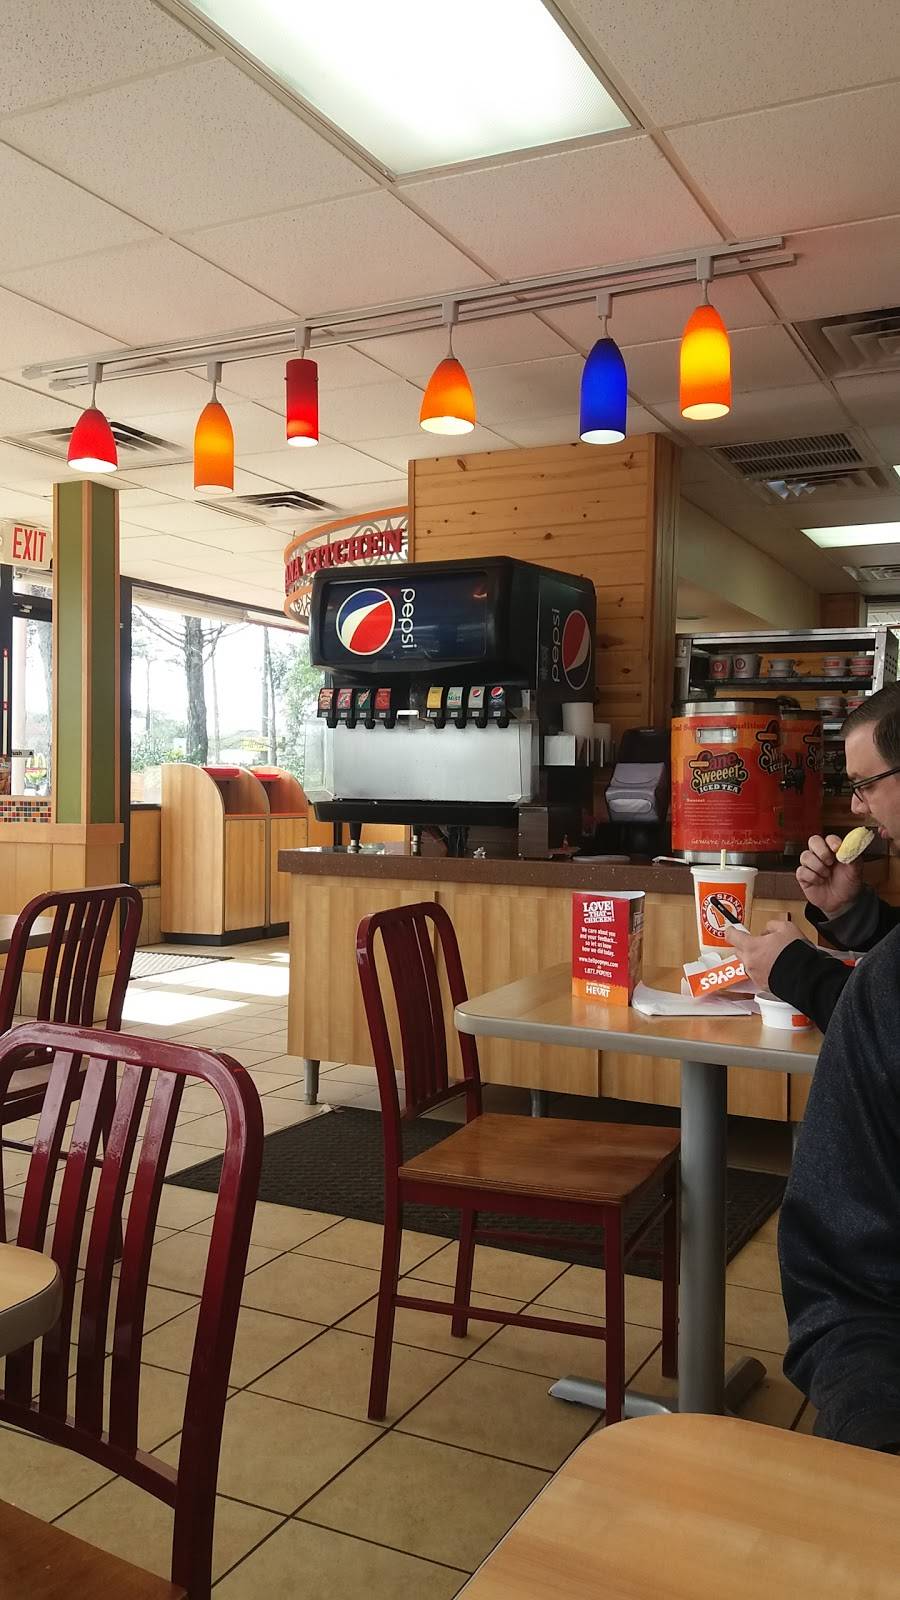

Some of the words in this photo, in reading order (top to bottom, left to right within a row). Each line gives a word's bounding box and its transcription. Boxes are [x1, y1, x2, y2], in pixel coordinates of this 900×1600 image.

[12, 526, 47, 562] EXIT
[304, 528, 403, 573] KITCHEN
[398, 587, 417, 649] pepsi
[551, 608, 561, 682] pepsi
[691, 762, 748, 789] Sweeeet
[699, 783, 721, 793] ICED
[721, 784, 739, 793] TEA
[583, 901, 611, 912] LOVE
